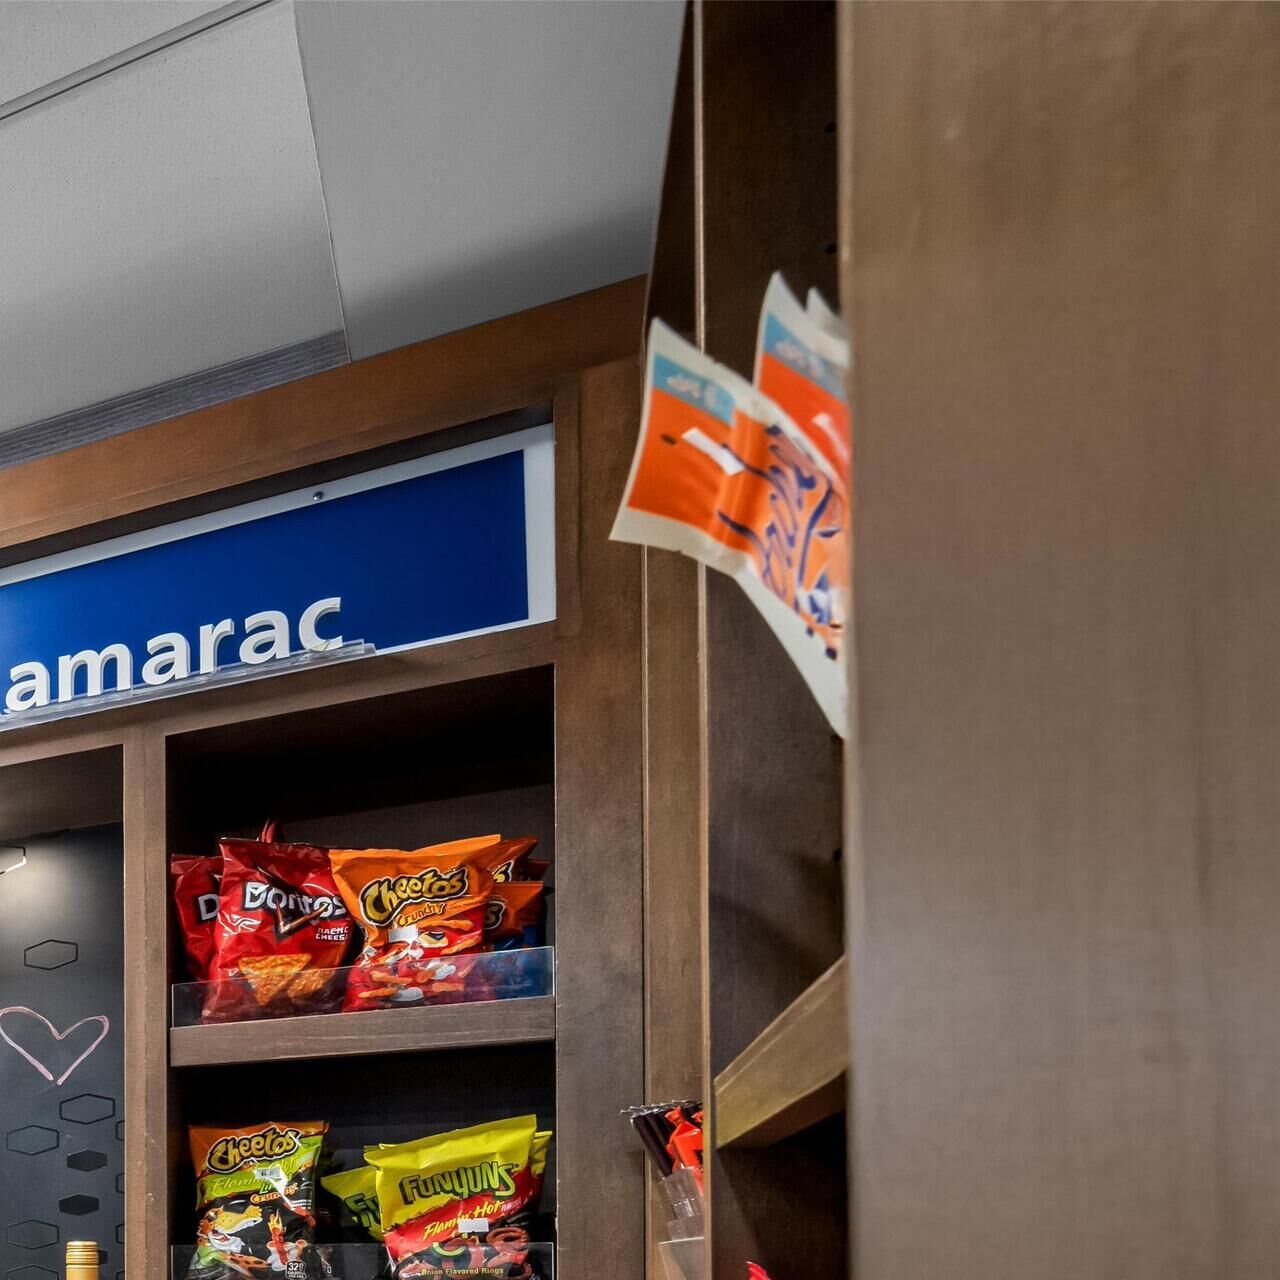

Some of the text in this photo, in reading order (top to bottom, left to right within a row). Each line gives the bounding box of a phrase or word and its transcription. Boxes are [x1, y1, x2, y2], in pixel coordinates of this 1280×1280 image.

[244, 881, 348, 918] Doritos
[361, 868, 468, 925] Cheetos
[396, 902, 448, 927] Crunchy
[208, 1127, 301, 1172] Cheetos
[399, 1161, 517, 1205] FUNYUNS
[473, 1200, 501, 1219] Hot
[421, 1267, 504, 1276] Onion Flavored Rings
